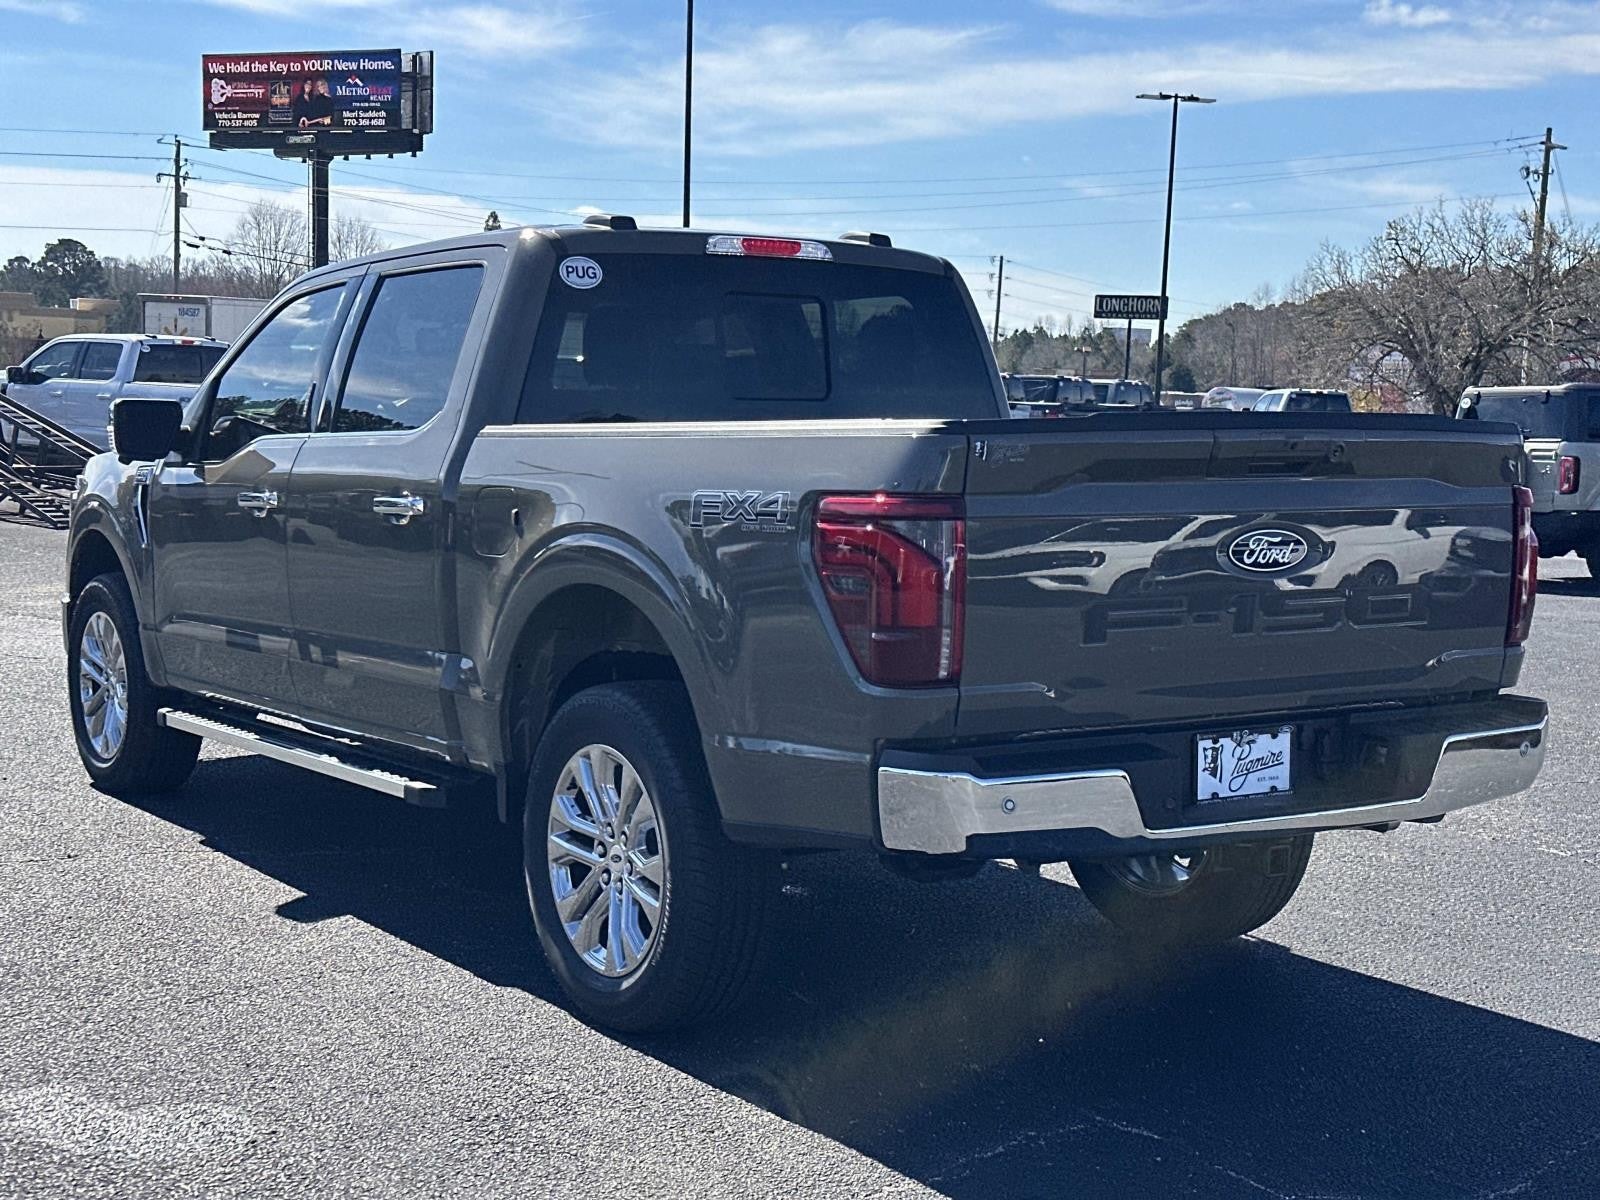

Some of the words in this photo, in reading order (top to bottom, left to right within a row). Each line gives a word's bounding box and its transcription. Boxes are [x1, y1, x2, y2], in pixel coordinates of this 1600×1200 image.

[208, 62, 225, 74] We
[226, 61, 250, 73] Hold
[251, 60, 268, 73] the
[269, 60, 289, 75] Key
[290, 61, 301, 72] to
[302, 59, 333, 71] YOUR
[333, 59, 358, 71] New
[360, 58, 395, 70] Home.
[237, 111, 261, 119] Barrow
[358, 110, 387, 118] Suddeth
[565, 265, 598, 280] PUG
[1095, 296, 1161, 313] LONGHORN
[689, 489, 790, 529] FX4
[1243, 535, 1295, 564] Ford
[1080, 588, 1429, 647] F-150
[1229, 743, 1284, 792] Pugmire
